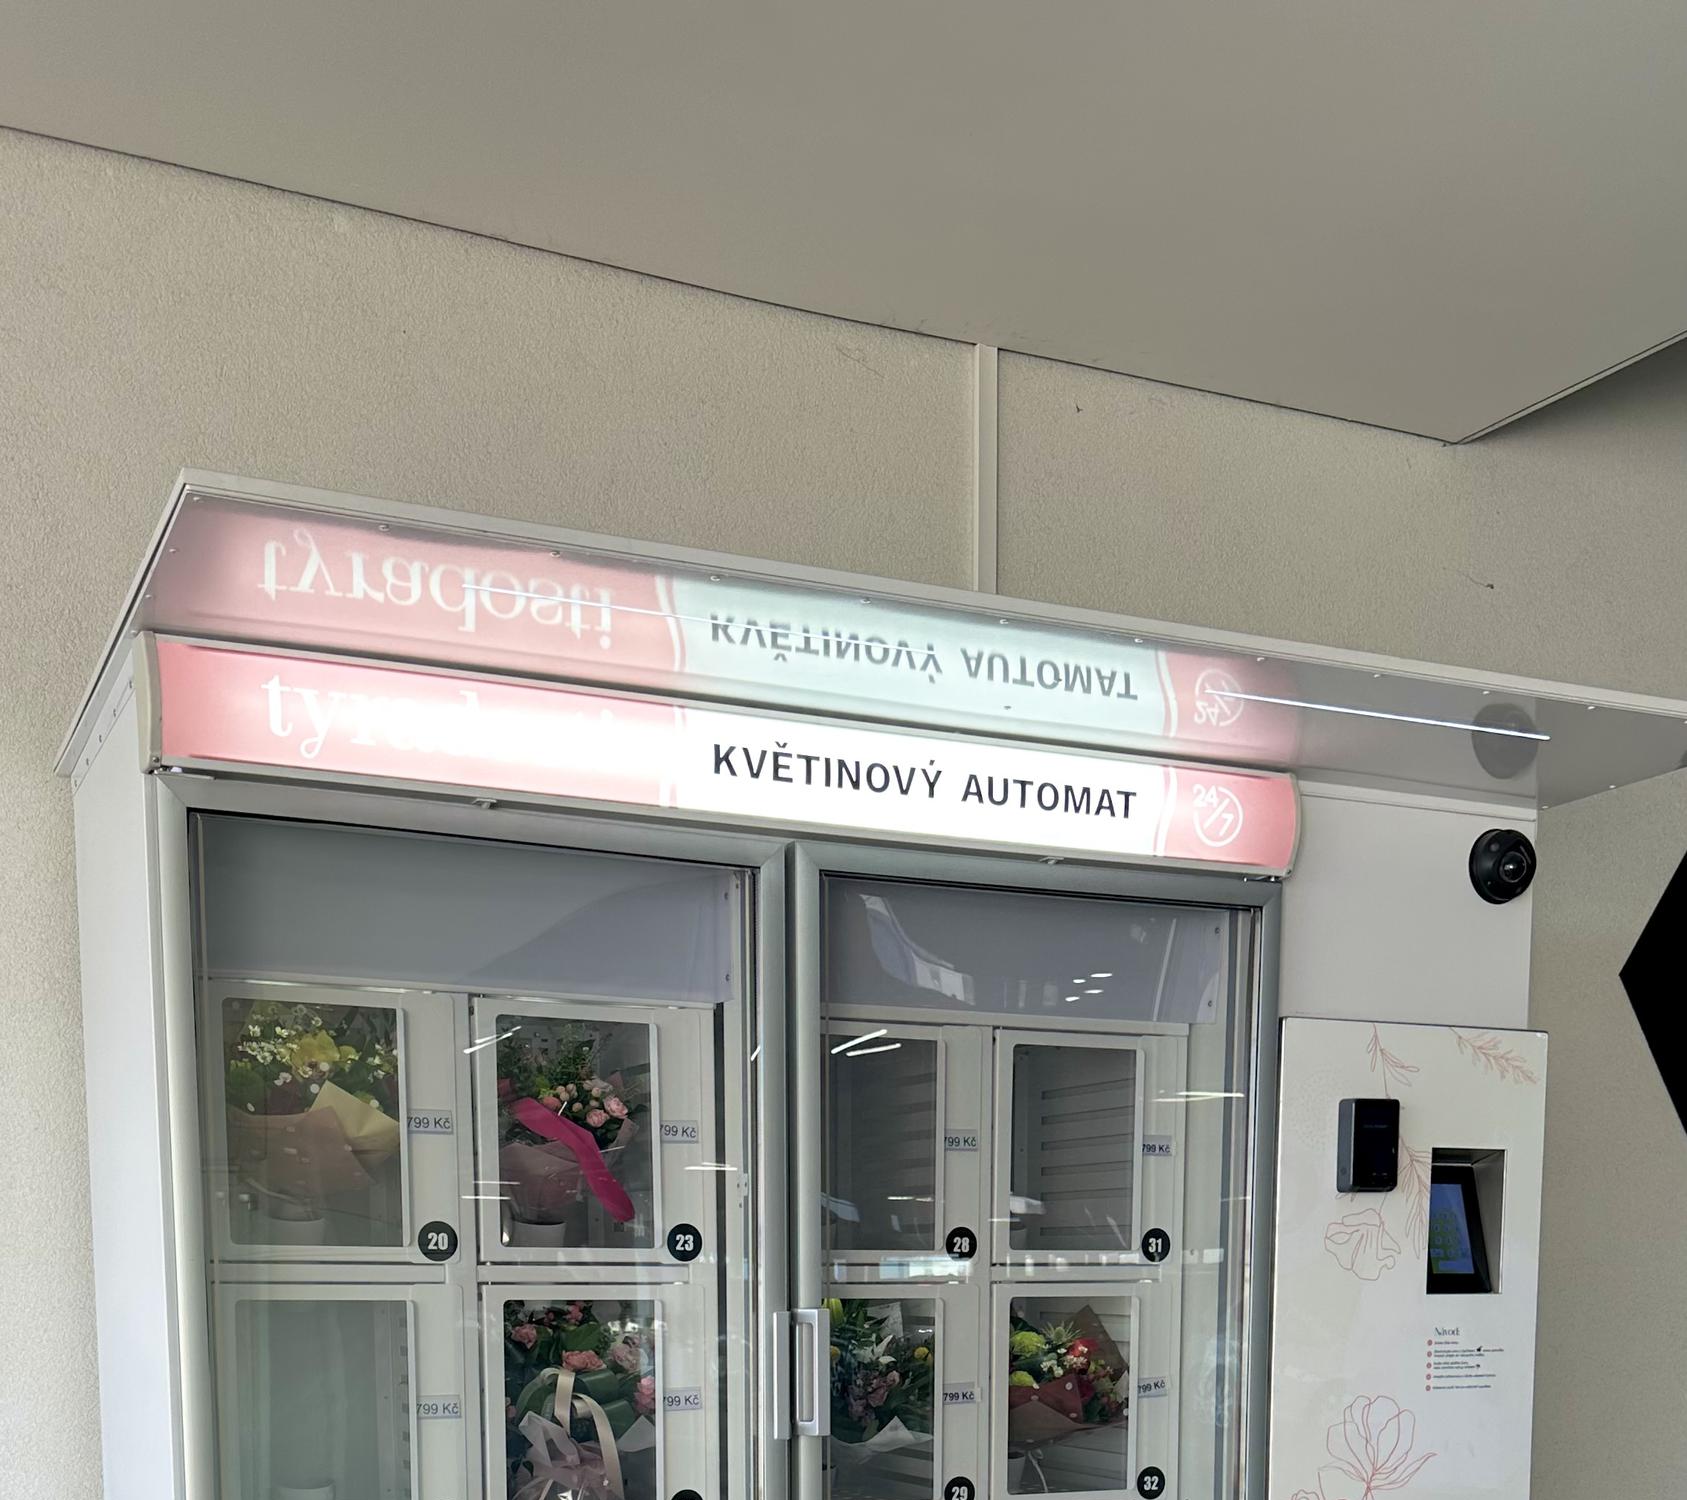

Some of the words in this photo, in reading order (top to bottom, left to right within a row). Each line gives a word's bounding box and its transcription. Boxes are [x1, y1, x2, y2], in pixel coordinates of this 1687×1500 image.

[713, 740, 942, 799] KVĚTINOVÝ
[961, 773, 1137, 818] AUTOMAT
[1193, 783, 1235, 837] 24/7
[407, 1116, 429, 1129] 799
[434, 1117, 451, 1129] Kč
[682, 1126, 696, 1138] Kč
[963, 1136, 976, 1147] Kč
[1142, 1144, 1157, 1154] 799
[1158, 1144, 1170, 1154] Kč
[427, 1232, 449, 1250] 20
[676, 1234, 694, 1252] 23
[953, 1236, 970, 1253] 28
[1148, 1238, 1162, 1253] 31
[1138, 1383, 1152, 1394] 799
[1154, 1380, 1166, 1390] Kč
[685, 1394, 700, 1405] Kč
[944, 1392, 960, 1402] 799
[962, 1390, 974, 1400] Kč
[416, 1404, 439, 1415] 799
[443, 1403, 459, 1414] Kč
[1143, 1476, 1159, 1491] 32
